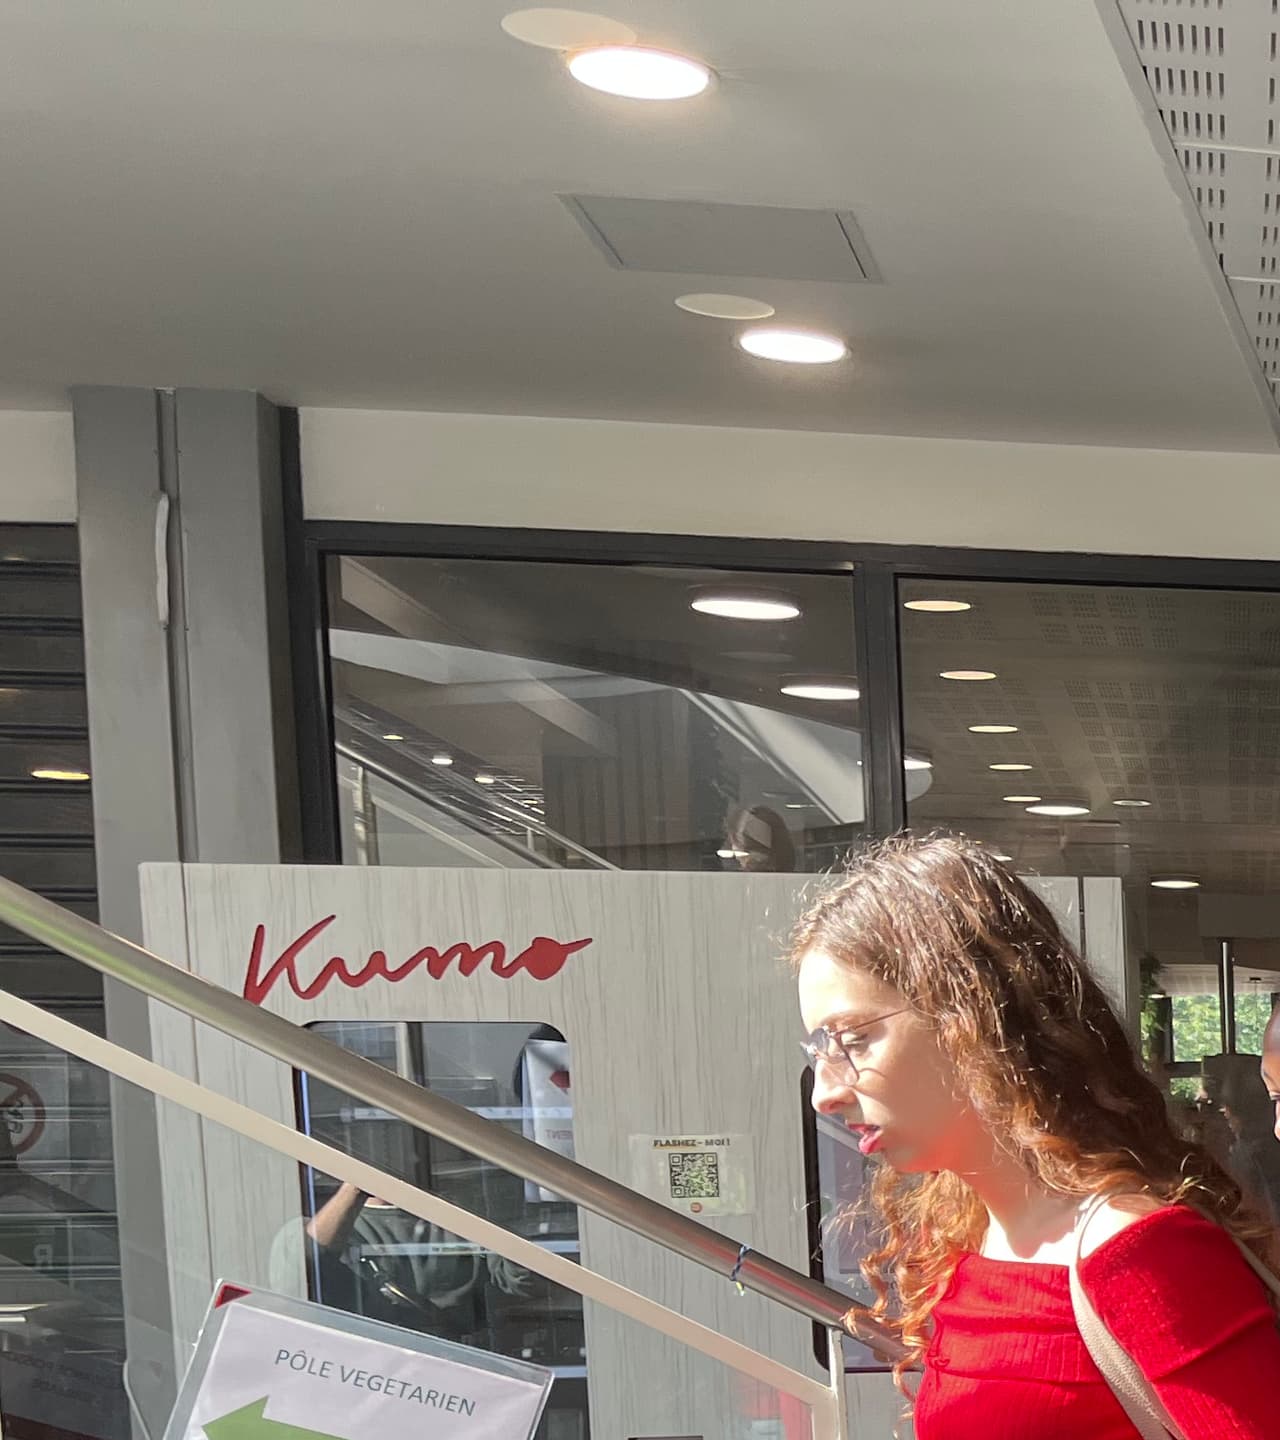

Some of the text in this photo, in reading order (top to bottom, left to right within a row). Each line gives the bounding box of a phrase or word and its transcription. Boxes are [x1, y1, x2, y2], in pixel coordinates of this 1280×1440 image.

[242, 914, 594, 1003] Kumo
[653, 1138, 697, 1147] FLASHEZ
[274, 1348, 477, 1417] PÔLE VEGETARIEN
